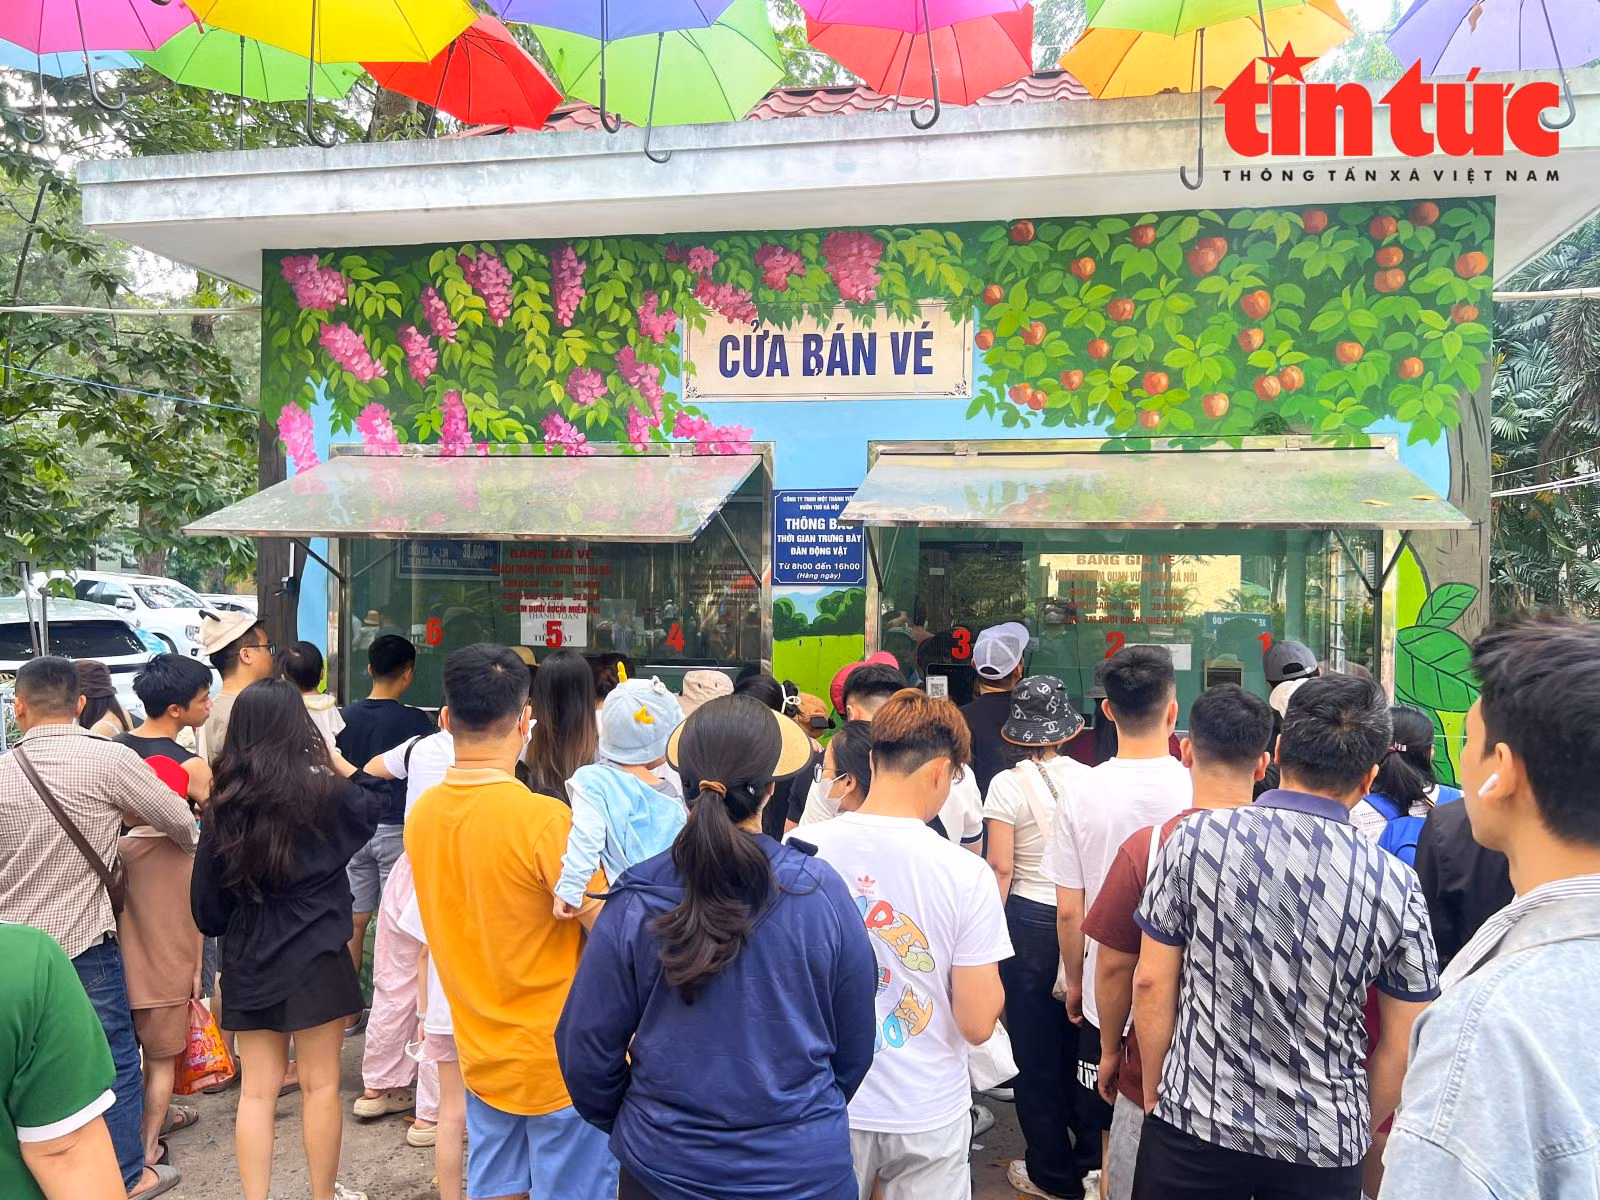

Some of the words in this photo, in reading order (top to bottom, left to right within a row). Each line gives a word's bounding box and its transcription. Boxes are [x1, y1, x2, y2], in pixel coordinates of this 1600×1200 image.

[719, 319, 790, 378] CỬA
[802, 323, 877, 377] BÁN
[890, 321, 934, 375] VÉ
[785, 516, 826, 530] THÔNG
[777, 533, 794, 542] THỜI
[796, 534, 816, 542] GIAN
[818, 534, 844, 542] TRƯNG
[846, 533, 861, 542] BÀY
[790, 546, 807, 556] ĐÀN
[809, 546, 831, 557] ĐỘNG
[833, 546, 848, 557] VẬT
[778, 562, 791, 570] Từ
[792, 562, 812, 570] 8h00
[815, 562, 831, 570] đến
[834, 562, 860, 570] 16h00
[796, 572, 818, 580] (Hàng
[820, 572, 841, 580] ngày)
[427, 617, 443, 646] 6
[546, 620, 562, 648] 5
[667, 623, 685, 652] 4
[952, 628, 972, 660] 3
[1256, 632, 1272, 656] 1
[1105, 630, 1125, 660] 2
